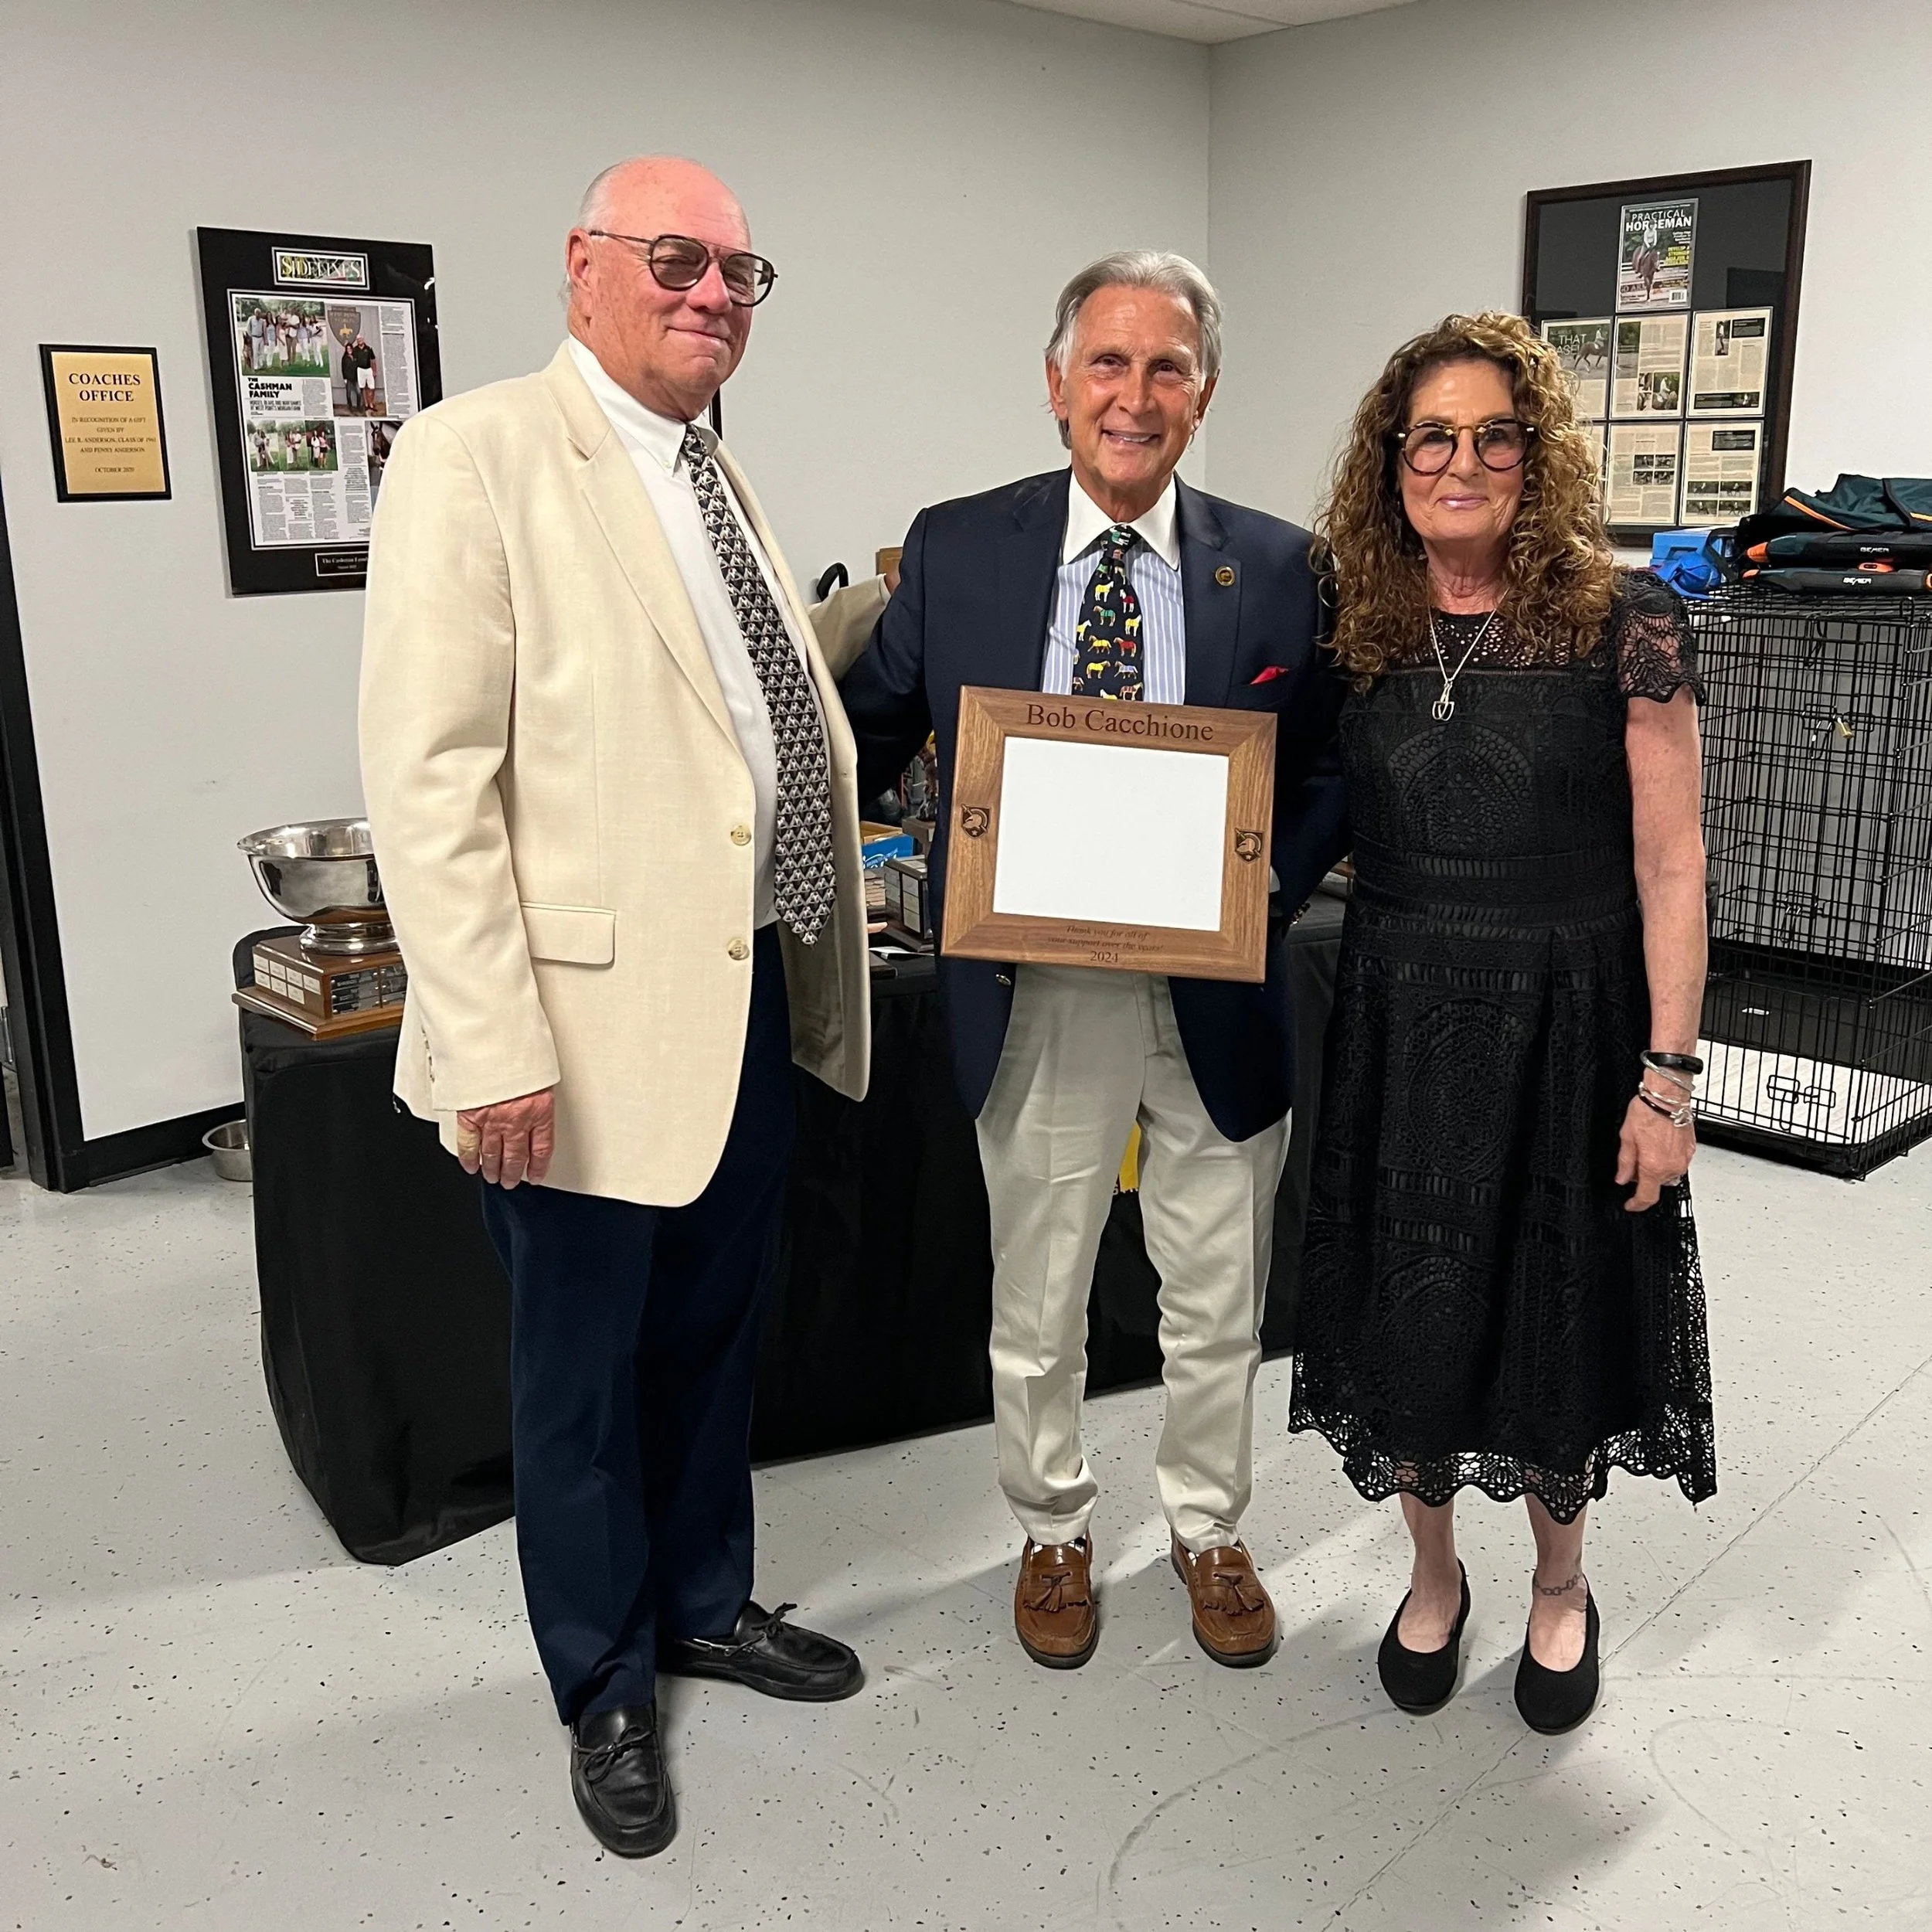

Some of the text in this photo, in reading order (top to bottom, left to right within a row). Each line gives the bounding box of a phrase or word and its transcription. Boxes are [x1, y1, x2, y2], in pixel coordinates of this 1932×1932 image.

[1631, 209, 1685, 221] PRACTICAL
[281, 257, 361, 278] SIDELINES
[1558, 334, 1587, 345] THAT
[69, 372, 141, 386] COACHES
[249, 383, 292, 391] CASHMAN
[79, 389, 134, 403] OFFICE
[1026, 703, 1213, 741] Bob Cacchione
[1066, 925, 1090, 935] Thank
[1107, 928, 1122, 938] for
[1124, 930, 1136, 938] all
[1138, 931, 1151, 941] of
[1068, 938, 1100, 947] support
[1122, 941, 1136, 951] the
[1090, 951, 1119, 964] 2024
